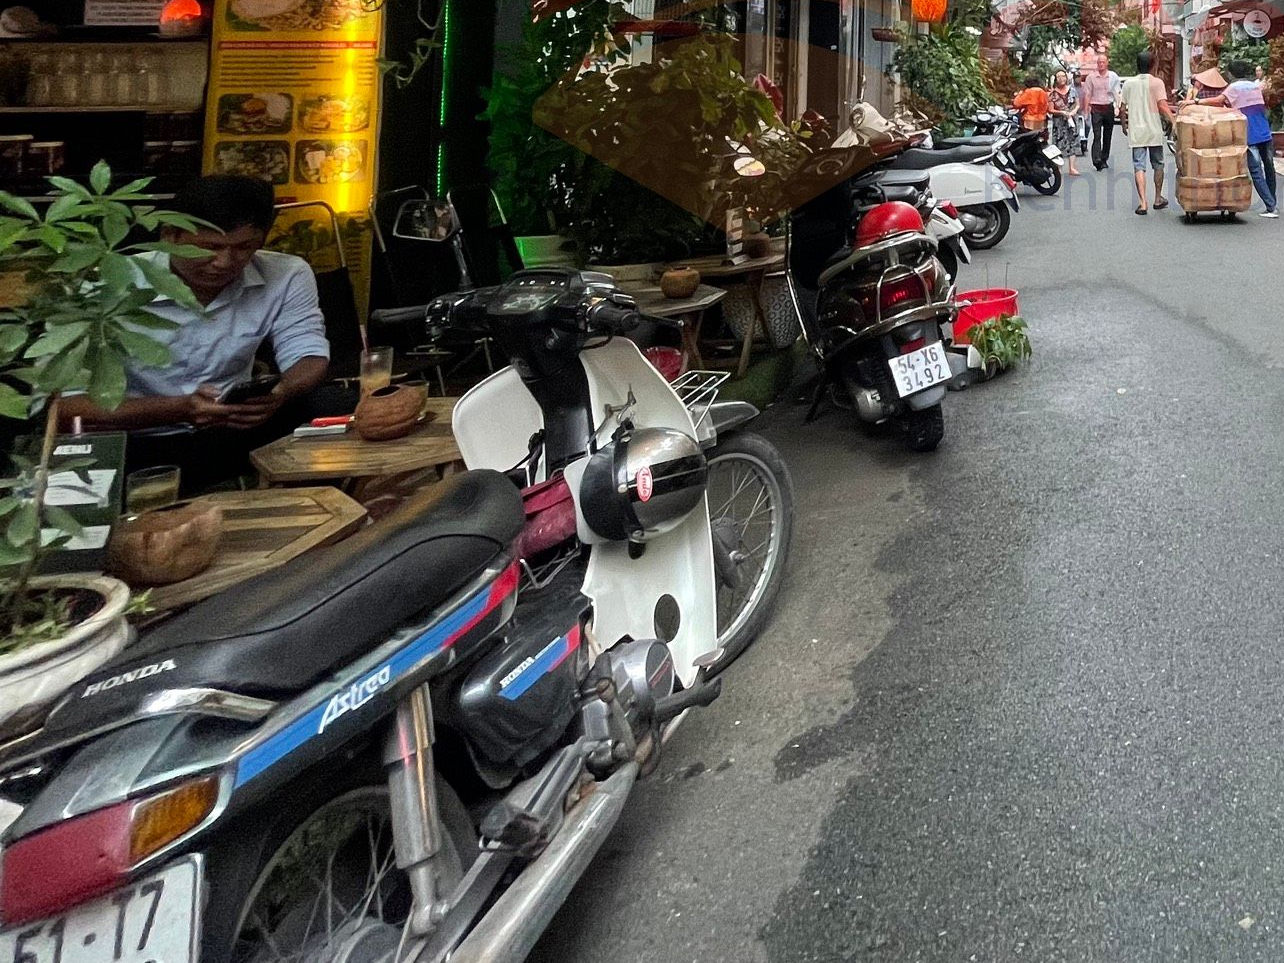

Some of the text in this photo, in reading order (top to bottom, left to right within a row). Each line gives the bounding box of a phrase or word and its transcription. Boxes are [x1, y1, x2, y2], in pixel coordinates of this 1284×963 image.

[897, 347, 939, 374] 54-X6
[902, 364, 946, 392] 3492
[81, 658, 178, 699] HONDA
[317, 664, 391, 735] Astrea
